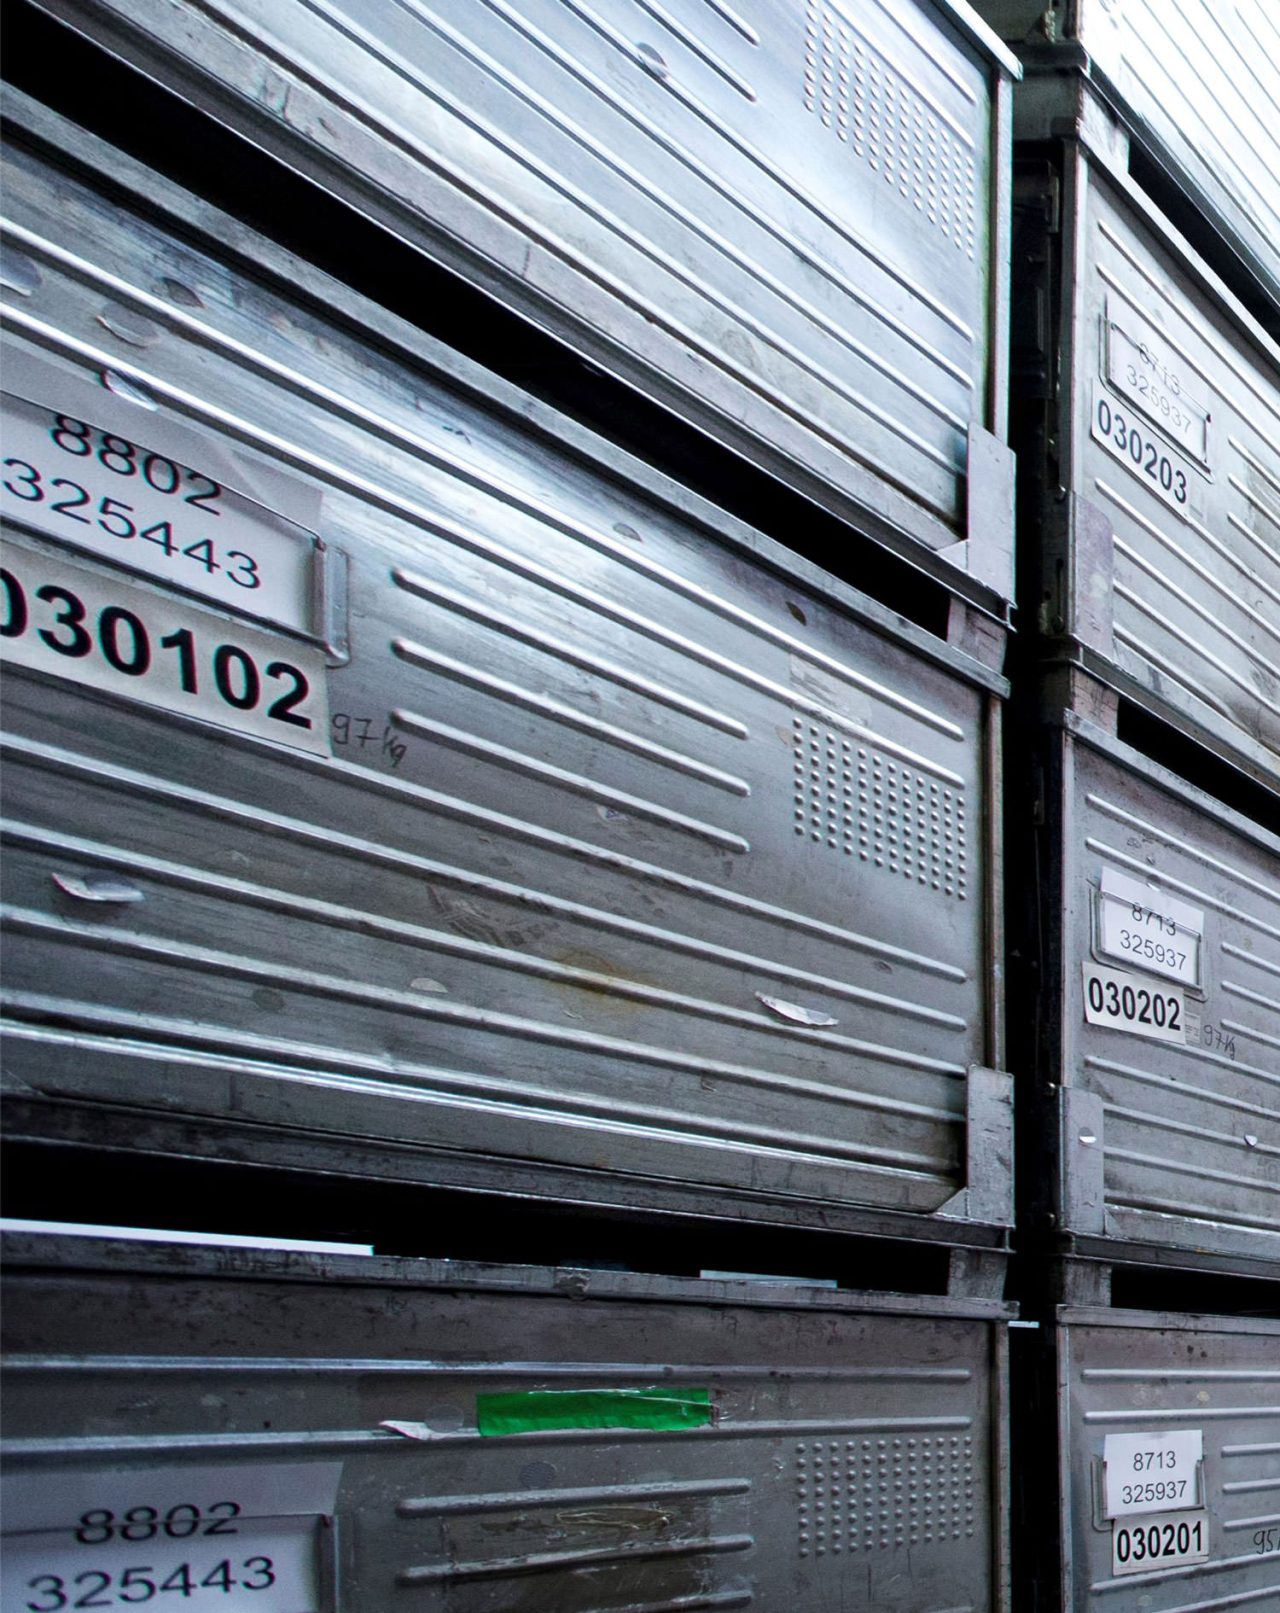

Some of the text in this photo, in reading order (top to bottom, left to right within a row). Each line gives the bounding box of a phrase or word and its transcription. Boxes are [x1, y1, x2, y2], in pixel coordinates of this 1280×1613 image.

[1126, 365, 1191, 432] 325937
[50, 414, 222, 516] 8802
[1099, 400, 1187, 504] 030203
[3, 458, 261, 589] 325443
[1120, 930, 1186, 970] 325937
[1088, 977, 1181, 1031] 030202
[1133, 1450, 1176, 1471] 8713
[1122, 1480, 1187, 1504] 325937
[75, 1501, 241, 1545] 8802
[1117, 1521, 1201, 1562] 030201
[26, 1556, 276, 1612] 325443
